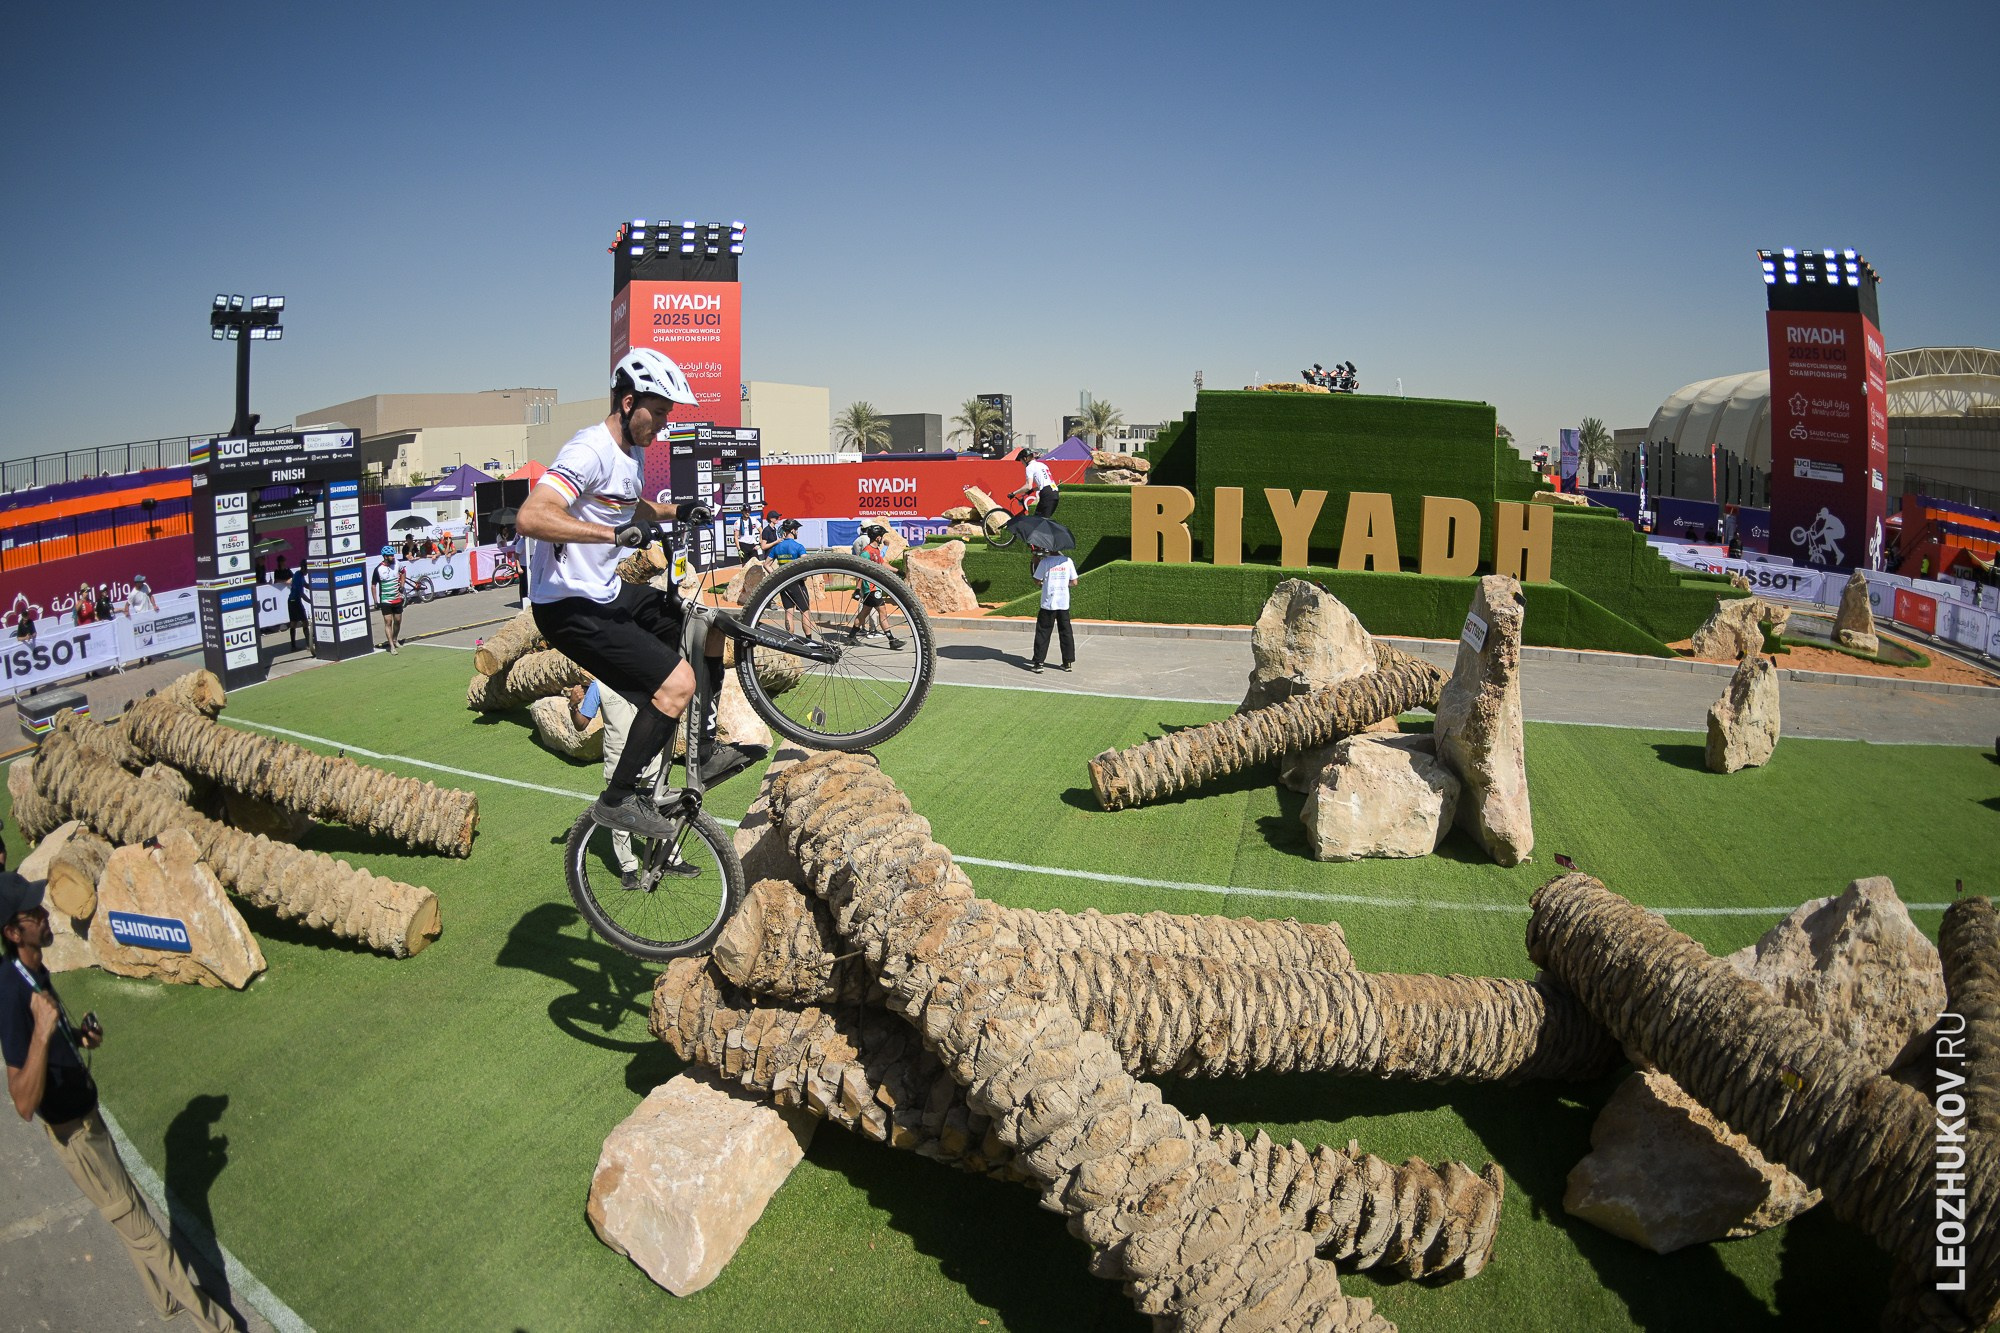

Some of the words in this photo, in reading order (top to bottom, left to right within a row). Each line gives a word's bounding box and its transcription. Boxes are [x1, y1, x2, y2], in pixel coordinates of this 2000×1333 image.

[653, 294, 721, 310] RIYADH
[653, 313, 690, 326] 2025
[694, 313, 721, 326] UCI
[1787, 327, 1845, 345] RIYADH
[1789, 346, 1820, 360] 2025
[1823, 348, 1847, 361] UCI
[1829, 364, 1847, 372] WORLD
[1789, 369, 1847, 379] CHAMPIONSHIPS
[1835, 410, 1850, 418] Sport
[700, 430, 711, 438] UCI
[1827, 431, 1850, 439] CYCLING
[274, 438, 294, 446] CYCLING
[223, 443, 245, 456] UCI
[249, 446, 265, 454] WORLD
[265, 443, 302, 452] CHAMPIONSHIPS
[700, 461, 711, 469] UCI
[1797, 460, 1810, 468] UCI
[272, 468, 306, 482] FINISH
[330, 485, 358, 493] SHIMANO
[858, 478, 917, 494] RIYADH
[222, 496, 244, 509] UCI
[858, 497, 890, 508] 2025
[893, 497, 917, 508] UCI
[1131, 486, 1553, 584] RIYADH
[221, 541, 245, 549] TISSOT
[229, 577, 242, 586] UCI
[335, 572, 362, 583] SHIMANO
[221, 594, 252, 605] SHIMANO
[343, 605, 362, 619] UCI
[137, 623, 154, 635] UCI
[230, 631, 253, 645] UCI
[0, 633, 91, 680] ISSOT
[919, 637, 929, 681] NATIONAL
[112, 920, 187, 944] SHIMANO
